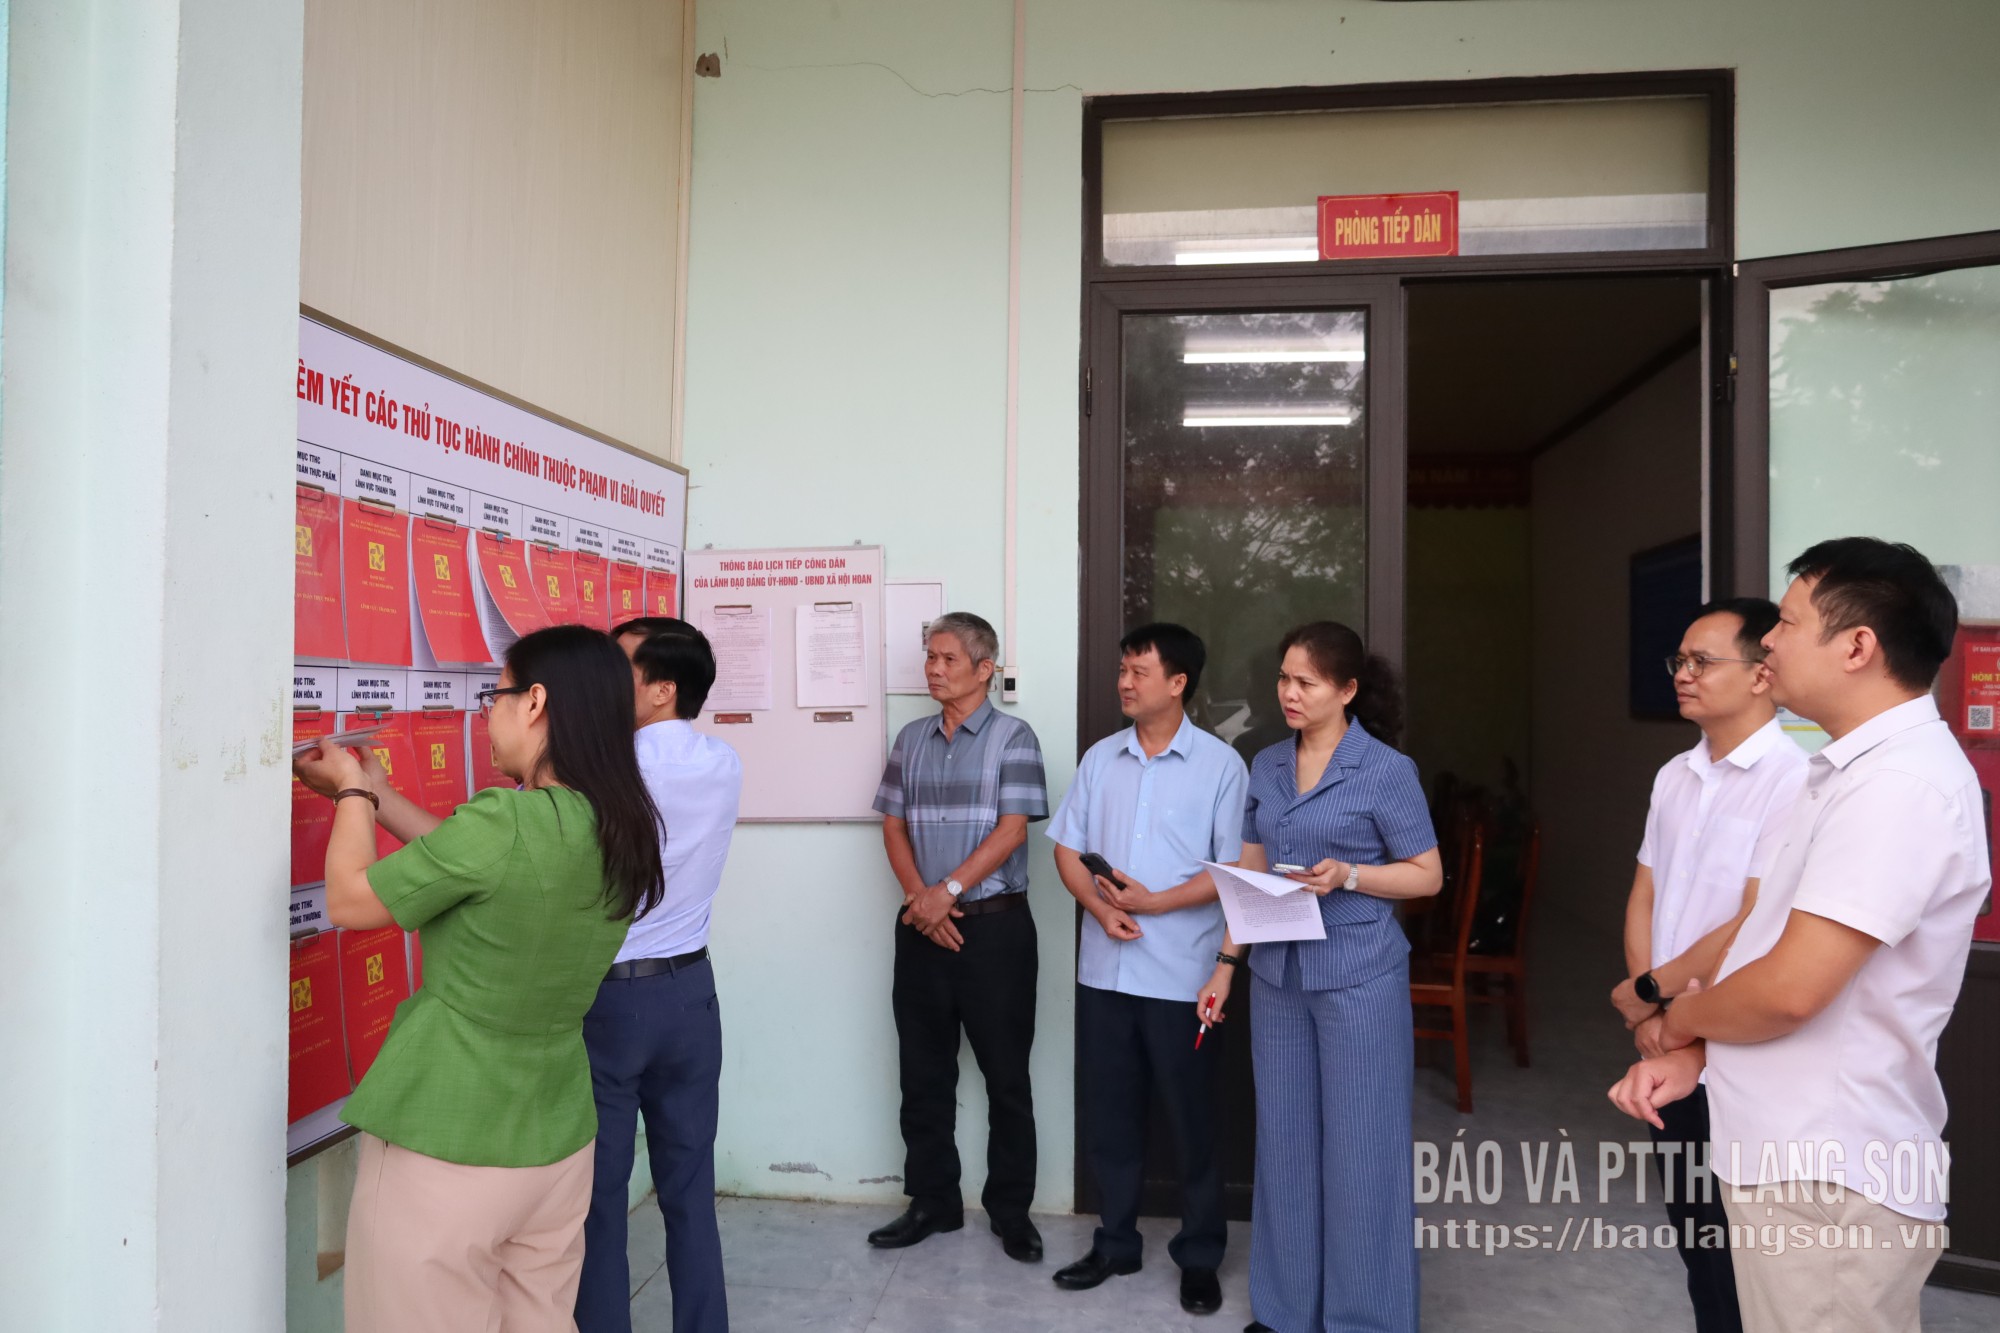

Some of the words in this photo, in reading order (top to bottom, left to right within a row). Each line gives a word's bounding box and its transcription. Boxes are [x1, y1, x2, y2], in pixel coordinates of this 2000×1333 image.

[1335, 209, 1379, 246] PHÒNG
[1382, 206, 1410, 244] TIẾP
[1413, 208, 1441, 243] DÂN
[330, 374, 360, 417] YẾT
[366, 390, 398, 430] CÁC
[402, 402, 430, 440] THỦ
[435, 416, 460, 454] TỤC
[465, 426, 500, 464] HÀNH
[504, 442, 539, 477] CHÍNH
[542, 456, 576, 492] THUỘC
[579, 468, 607, 501] PHẠM
[610, 479, 618, 501] VI
[620, 480, 638, 509] GIẢI
[640, 490, 666, 517] QUYẾT
[375, 485, 388, 494] THANH
[720, 559, 745, 571] THÔNG
[748, 558, 764, 570] BÁO
[766, 560, 783, 572] LỊCH
[786, 557, 802, 569] TIẾP
[805, 557, 826, 569] CÔNG
[829, 557, 846, 568] DÂN
[694, 576, 708, 588] CỦA
[710, 576, 728, 588] LÃNH
[730, 578, 744, 590] ĐẠO
[746, 573, 766, 587] ĐẢNG
[768, 573, 798, 586] ỦY-HĐND
[805, 575, 825, 585] UBND
[826, 573, 836, 585] XÃ
[838, 573, 850, 586] HỘI
[852, 574, 871, 584] HOAN
[304, 678, 315, 686] TTHC
[370, 680, 379, 688] MỤC
[352, 691, 361, 699] LĨNH
